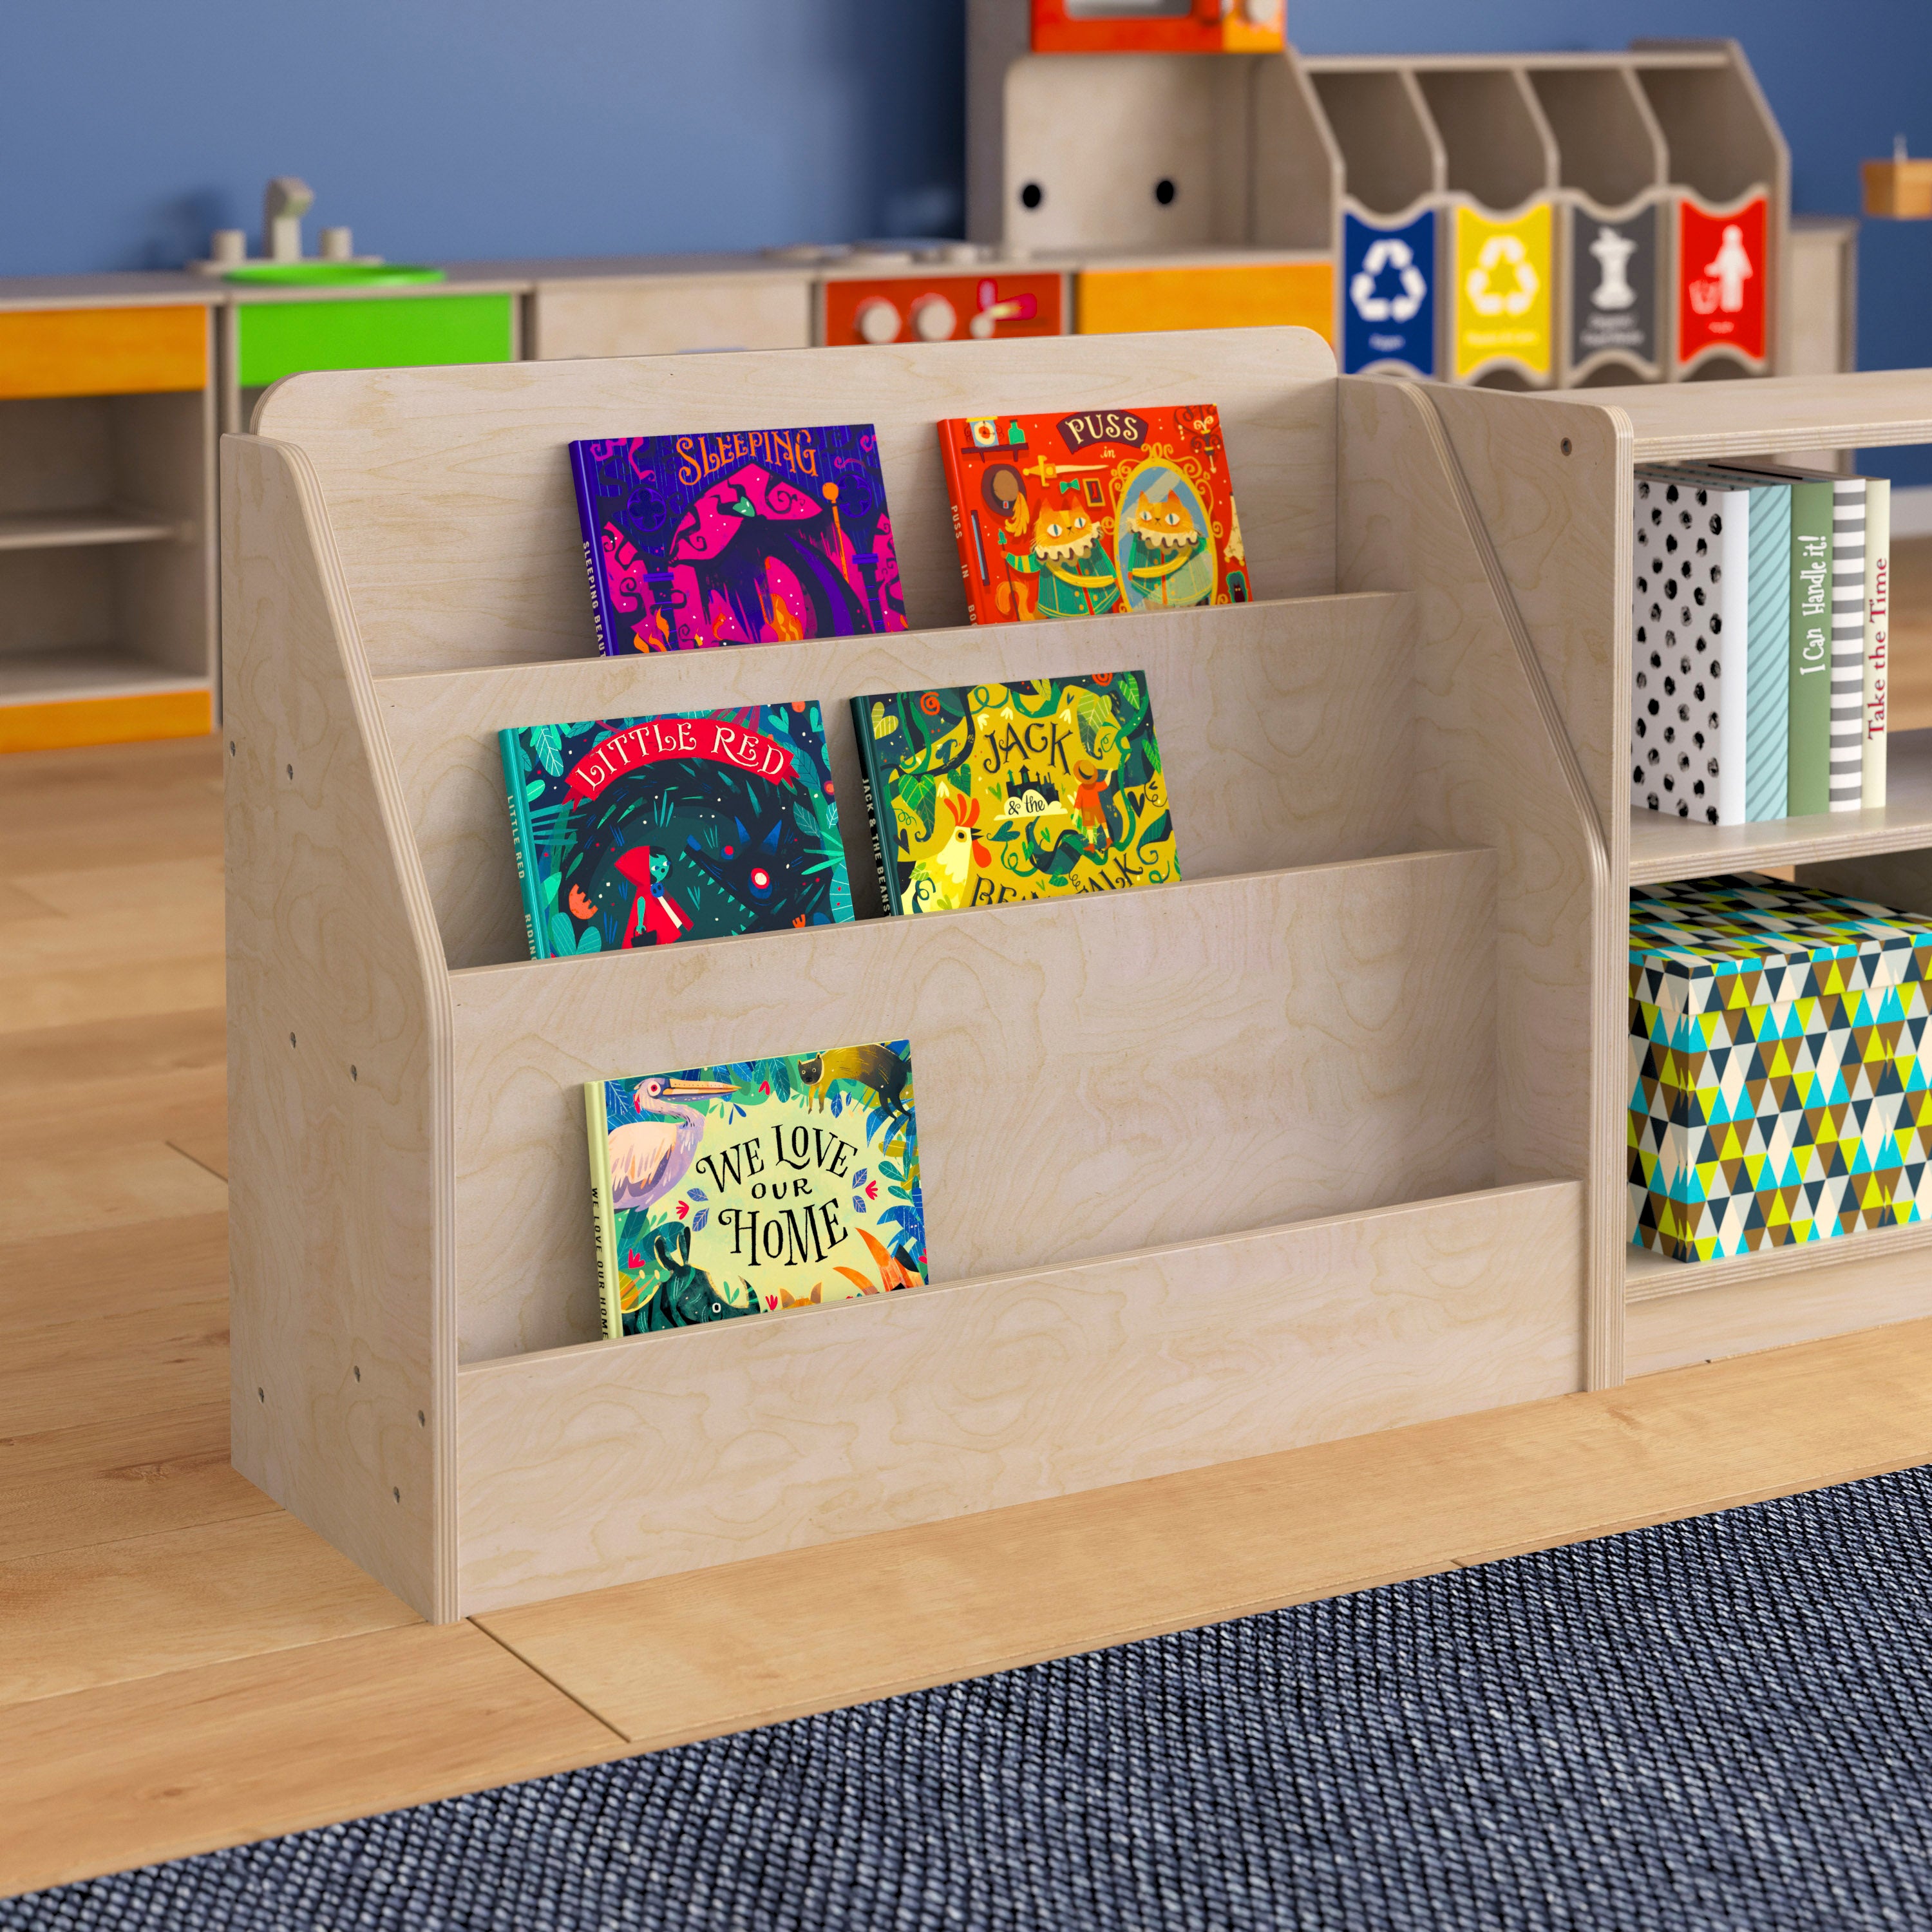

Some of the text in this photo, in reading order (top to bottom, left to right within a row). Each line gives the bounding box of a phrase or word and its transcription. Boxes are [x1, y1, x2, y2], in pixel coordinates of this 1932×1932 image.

[676, 429, 819, 486] SLEEPING
[1065, 413, 1139, 444] PUSS
[1099, 446, 1116, 459] in
[951, 505, 962, 539] PUSS
[961, 565, 969, 579] IN
[582, 541, 598, 609] SLEEPING
[1797, 535, 1828, 676] I Can Handle it!
[1868, 557, 1888, 741] Take the Time
[574, 723, 785, 790] LITTLE RED
[983, 721, 1074, 776] JACK
[862, 779, 874, 813] JACK
[869, 818, 876, 828] &
[1008, 793, 1046, 816] & the
[506, 795, 520, 846] LITTLE
[515, 852, 525, 880] RED
[871, 832, 882, 860] THE
[696, 1124, 858, 1193] WE LOVE
[751, 1178, 813, 1200] OUR
[591, 1187, 609, 1339] WE LOVE OUR HOME
[717, 1198, 848, 1267] HOME
